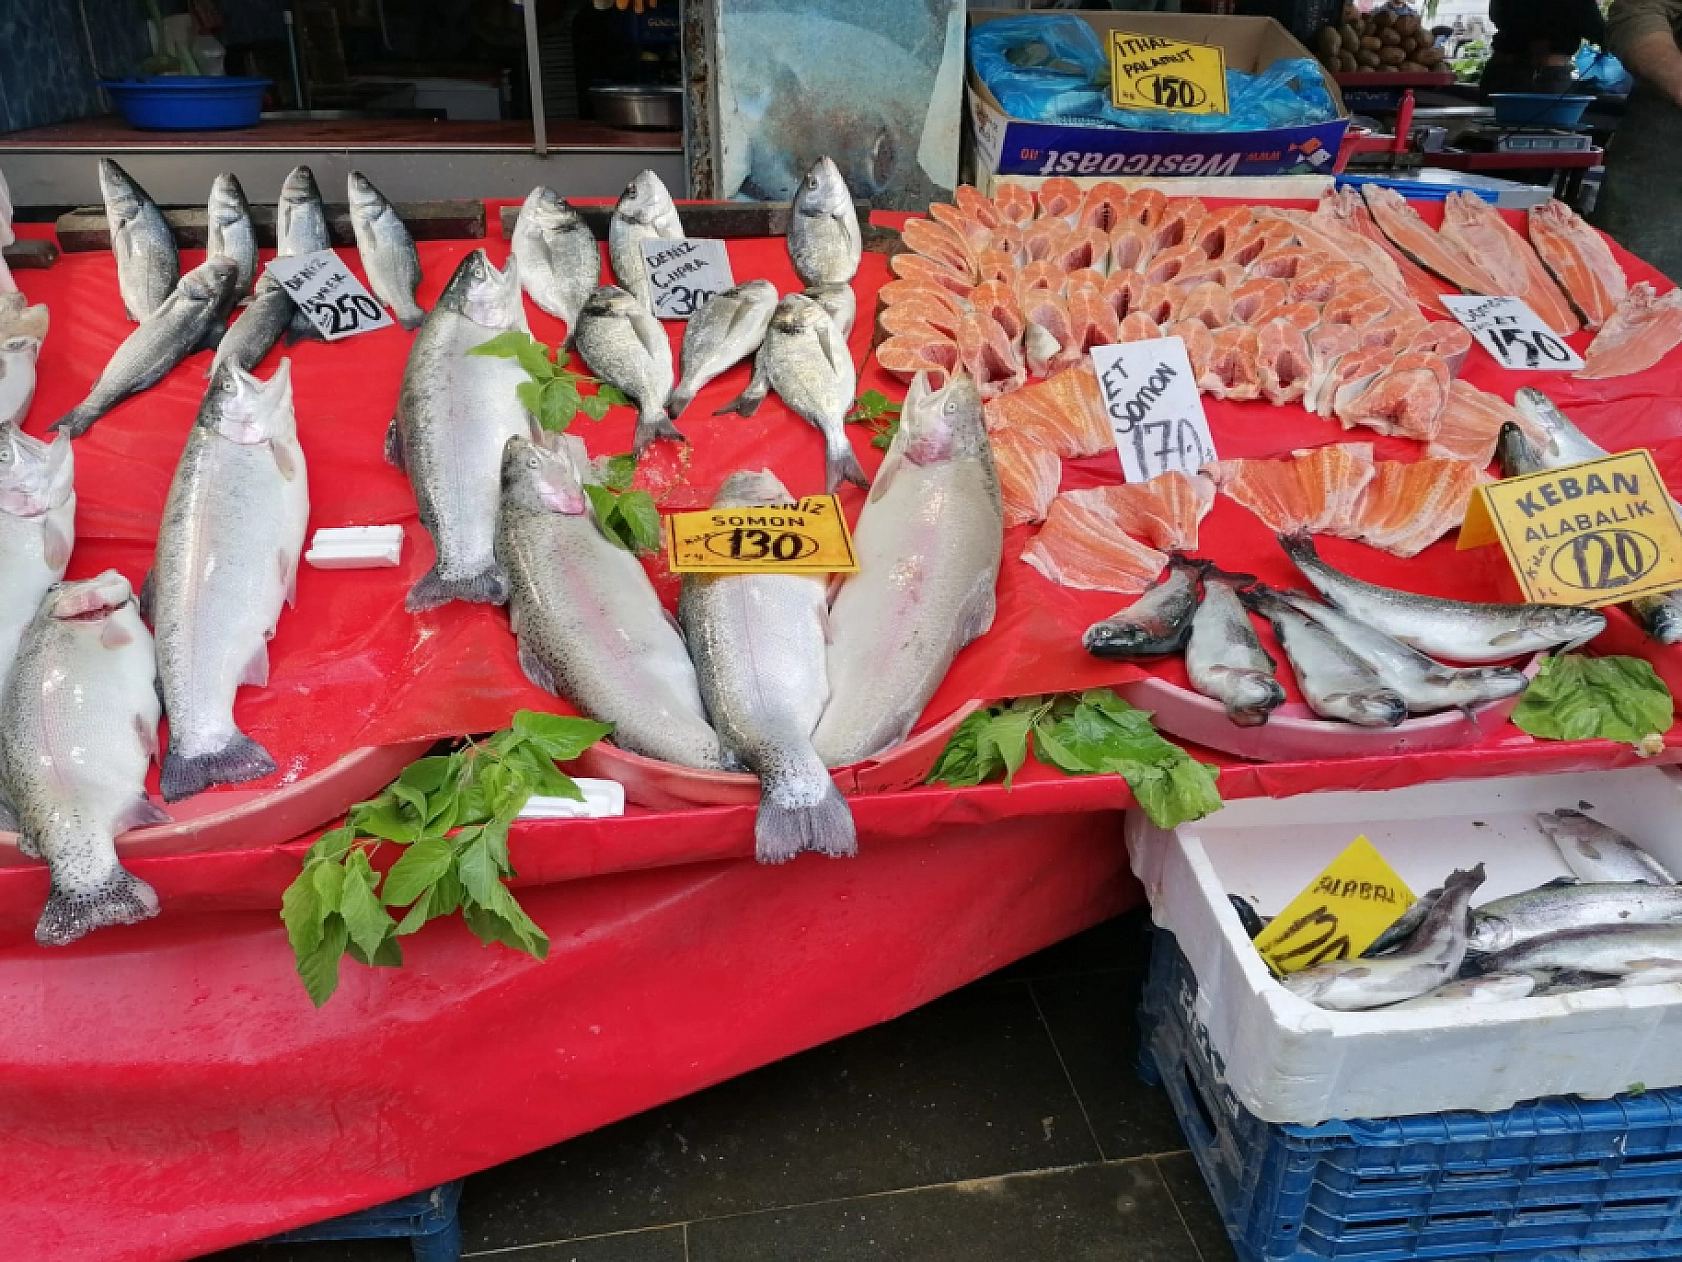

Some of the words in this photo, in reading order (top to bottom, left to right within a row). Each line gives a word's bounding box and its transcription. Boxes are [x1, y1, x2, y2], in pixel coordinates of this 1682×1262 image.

[1152, 75, 1195, 106] 150
[315, 293, 382, 334] 250
[1486, 329, 1571, 368] 150
[1101, 357, 1129, 401] ET
[1132, 417, 1206, 481] 170
[1515, 472, 1640, 518] KEBAN
[711, 516, 805, 527] SOMON
[1525, 500, 1655, 543] ALABALIK
[727, 527, 804, 560] 130
[1571, 532, 1645, 589] 120
